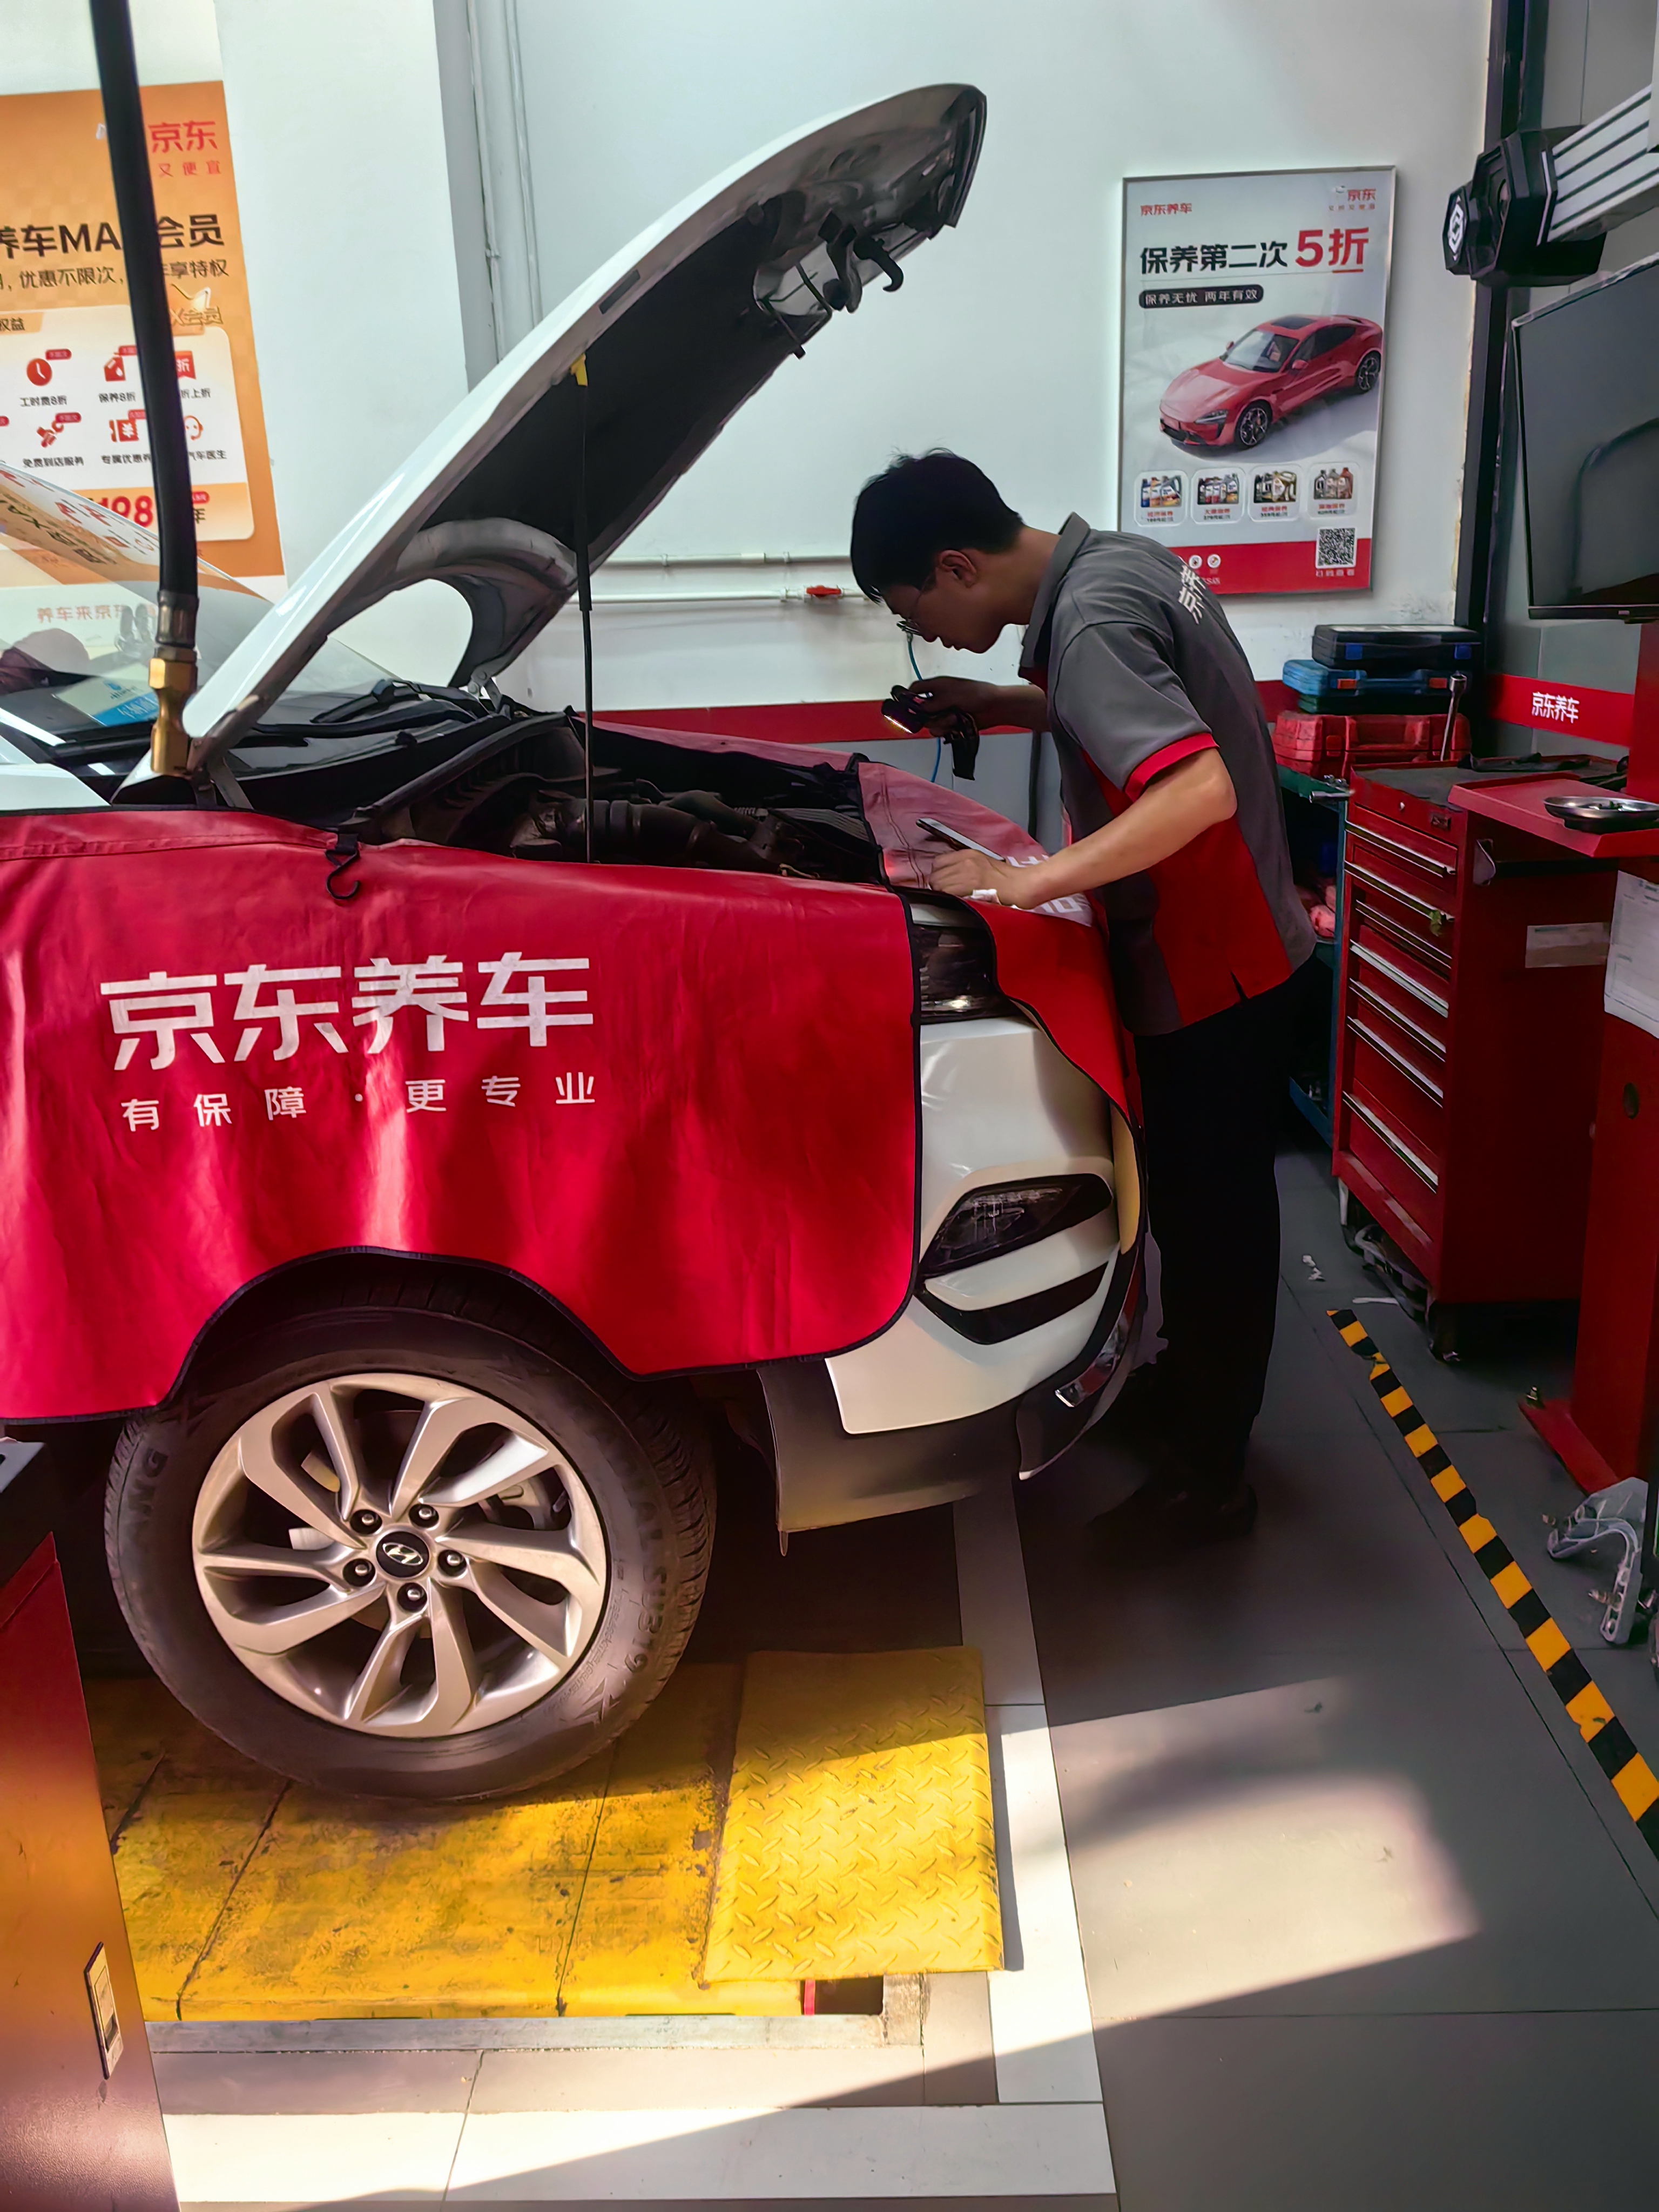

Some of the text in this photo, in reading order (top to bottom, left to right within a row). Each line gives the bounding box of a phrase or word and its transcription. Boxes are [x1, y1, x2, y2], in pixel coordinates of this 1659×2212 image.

[148, 120, 219, 154] 京东
[1140, 203, 1192, 217] 京东养车
[1347, 188, 1376, 201] 京东
[1532, 691, 1580, 724] 京东养车
[100, 952, 594, 1071] 京东养车
